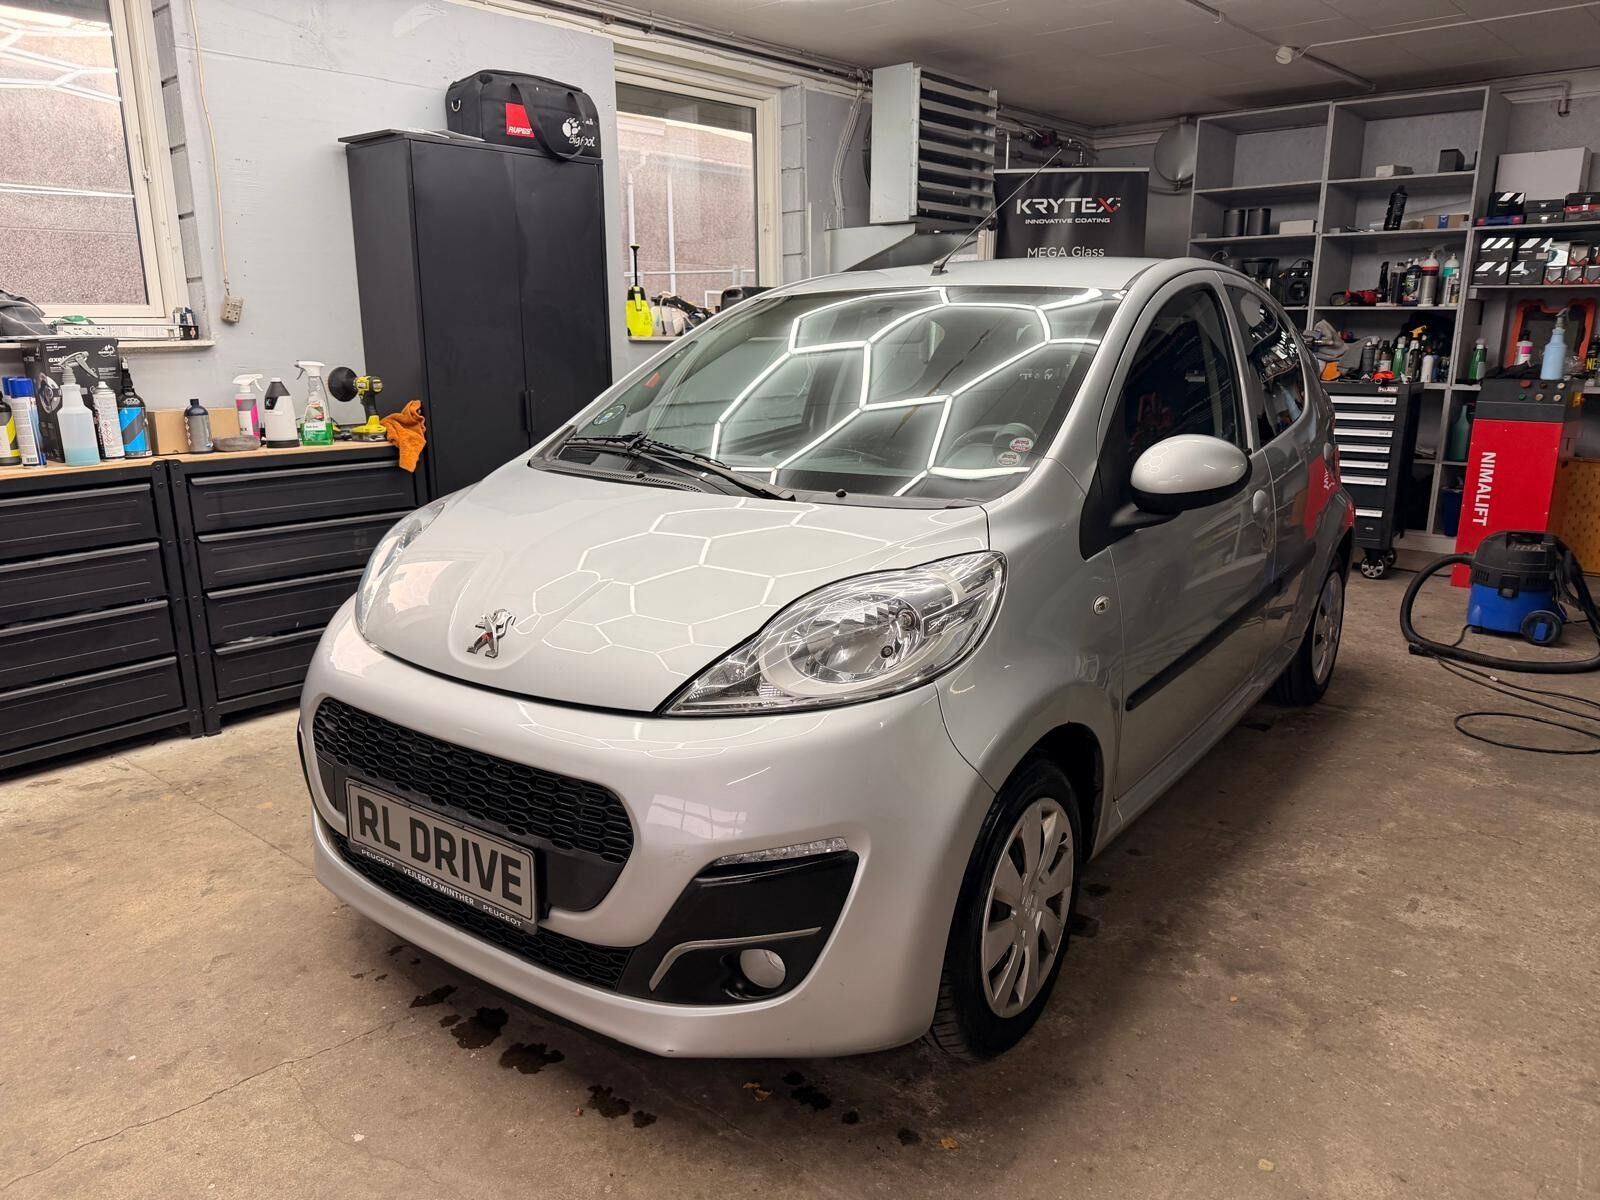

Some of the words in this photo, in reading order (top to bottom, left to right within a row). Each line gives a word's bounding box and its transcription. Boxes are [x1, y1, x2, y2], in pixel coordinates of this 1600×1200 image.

[508, 126, 531, 135] RUPES
[1027, 247, 1067, 258] MEGA
[1071, 246, 1105, 257] Glass
[1472, 451, 1496, 526] NIMALIFT
[357, 794, 401, 852] RL
[409, 816, 523, 906] DRIVE
[361, 849, 395, 868] PEUGEOT
[440, 884, 474, 906] WINTHER
[482, 904, 522, 928] PEUGEOT
